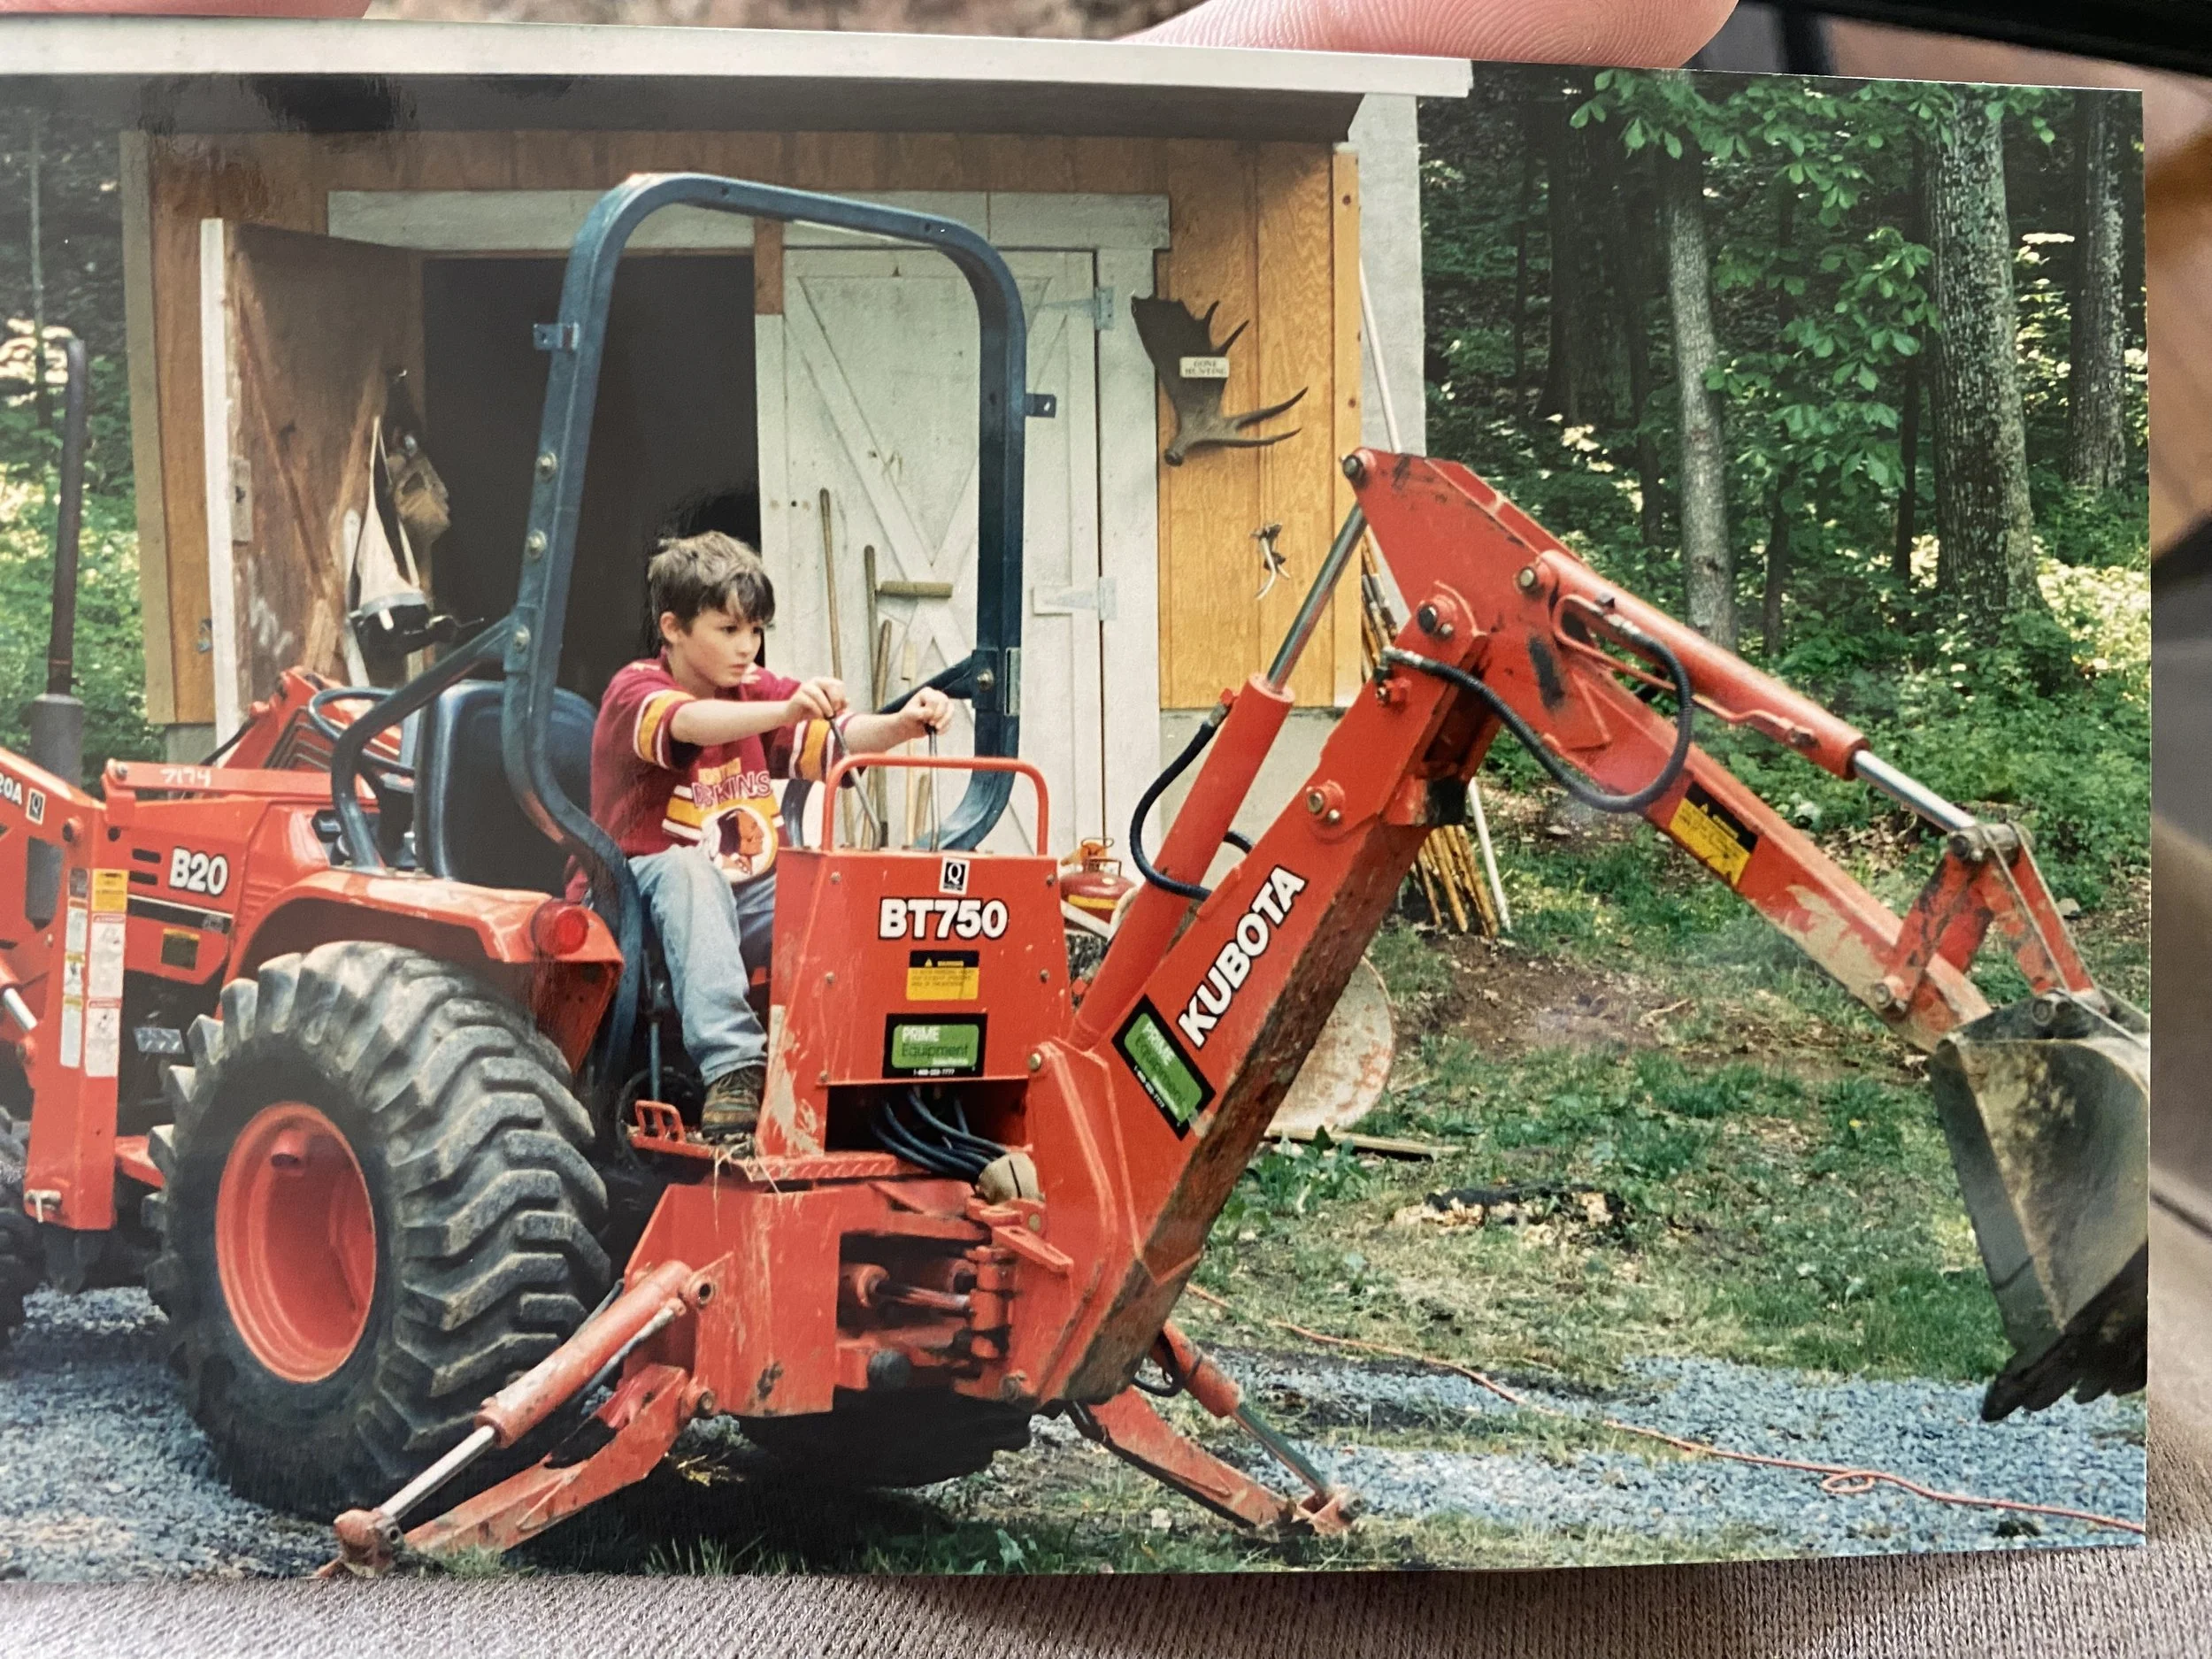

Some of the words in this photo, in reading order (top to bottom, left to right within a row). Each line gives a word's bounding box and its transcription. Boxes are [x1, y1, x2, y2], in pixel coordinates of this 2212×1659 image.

[160, 766, 211, 788] 7174
[169, 847, 228, 895] B20
[948, 864, 962, 885] Q
[879, 898, 1009, 939] BT750
[1178, 865, 1308, 1049] KUBOTA
[902, 1025, 940, 1042] PRIME
[1142, 1020, 1175, 1066] PRIME
[902, 1044, 968, 1059] Equipment
